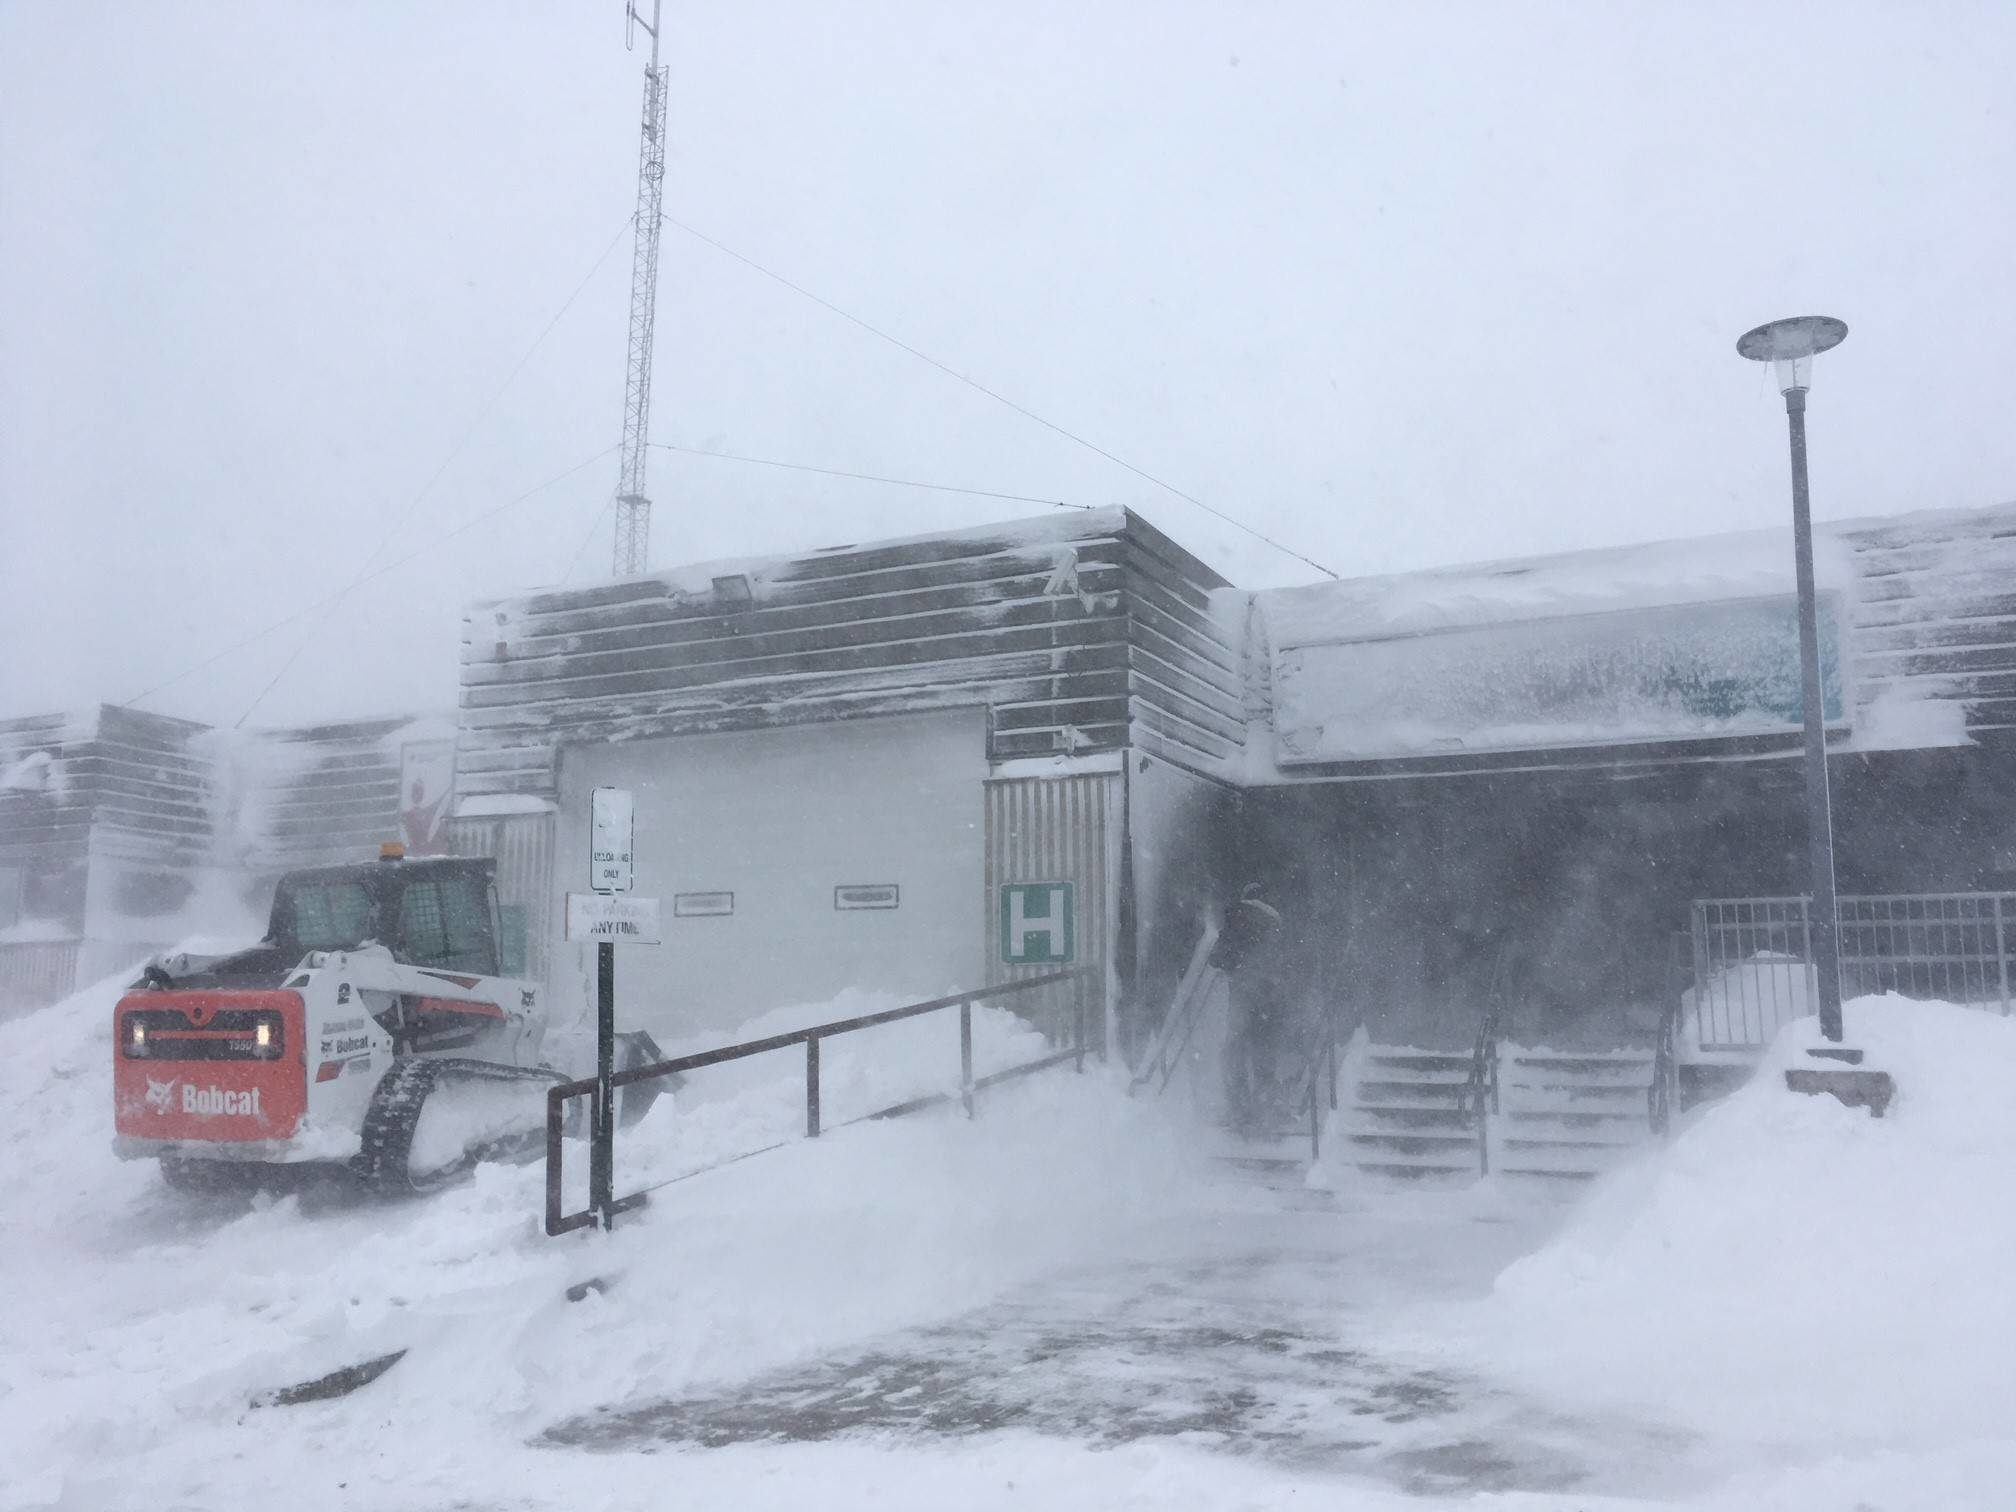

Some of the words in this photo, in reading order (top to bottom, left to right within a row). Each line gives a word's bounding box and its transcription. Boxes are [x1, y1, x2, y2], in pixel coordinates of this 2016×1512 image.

[603, 869, 619, 878] ONLY
[1010, 890, 1064, 956] H
[336, 1036, 368, 1053] Bobcat
[182, 1085, 260, 1114] Bobcat
